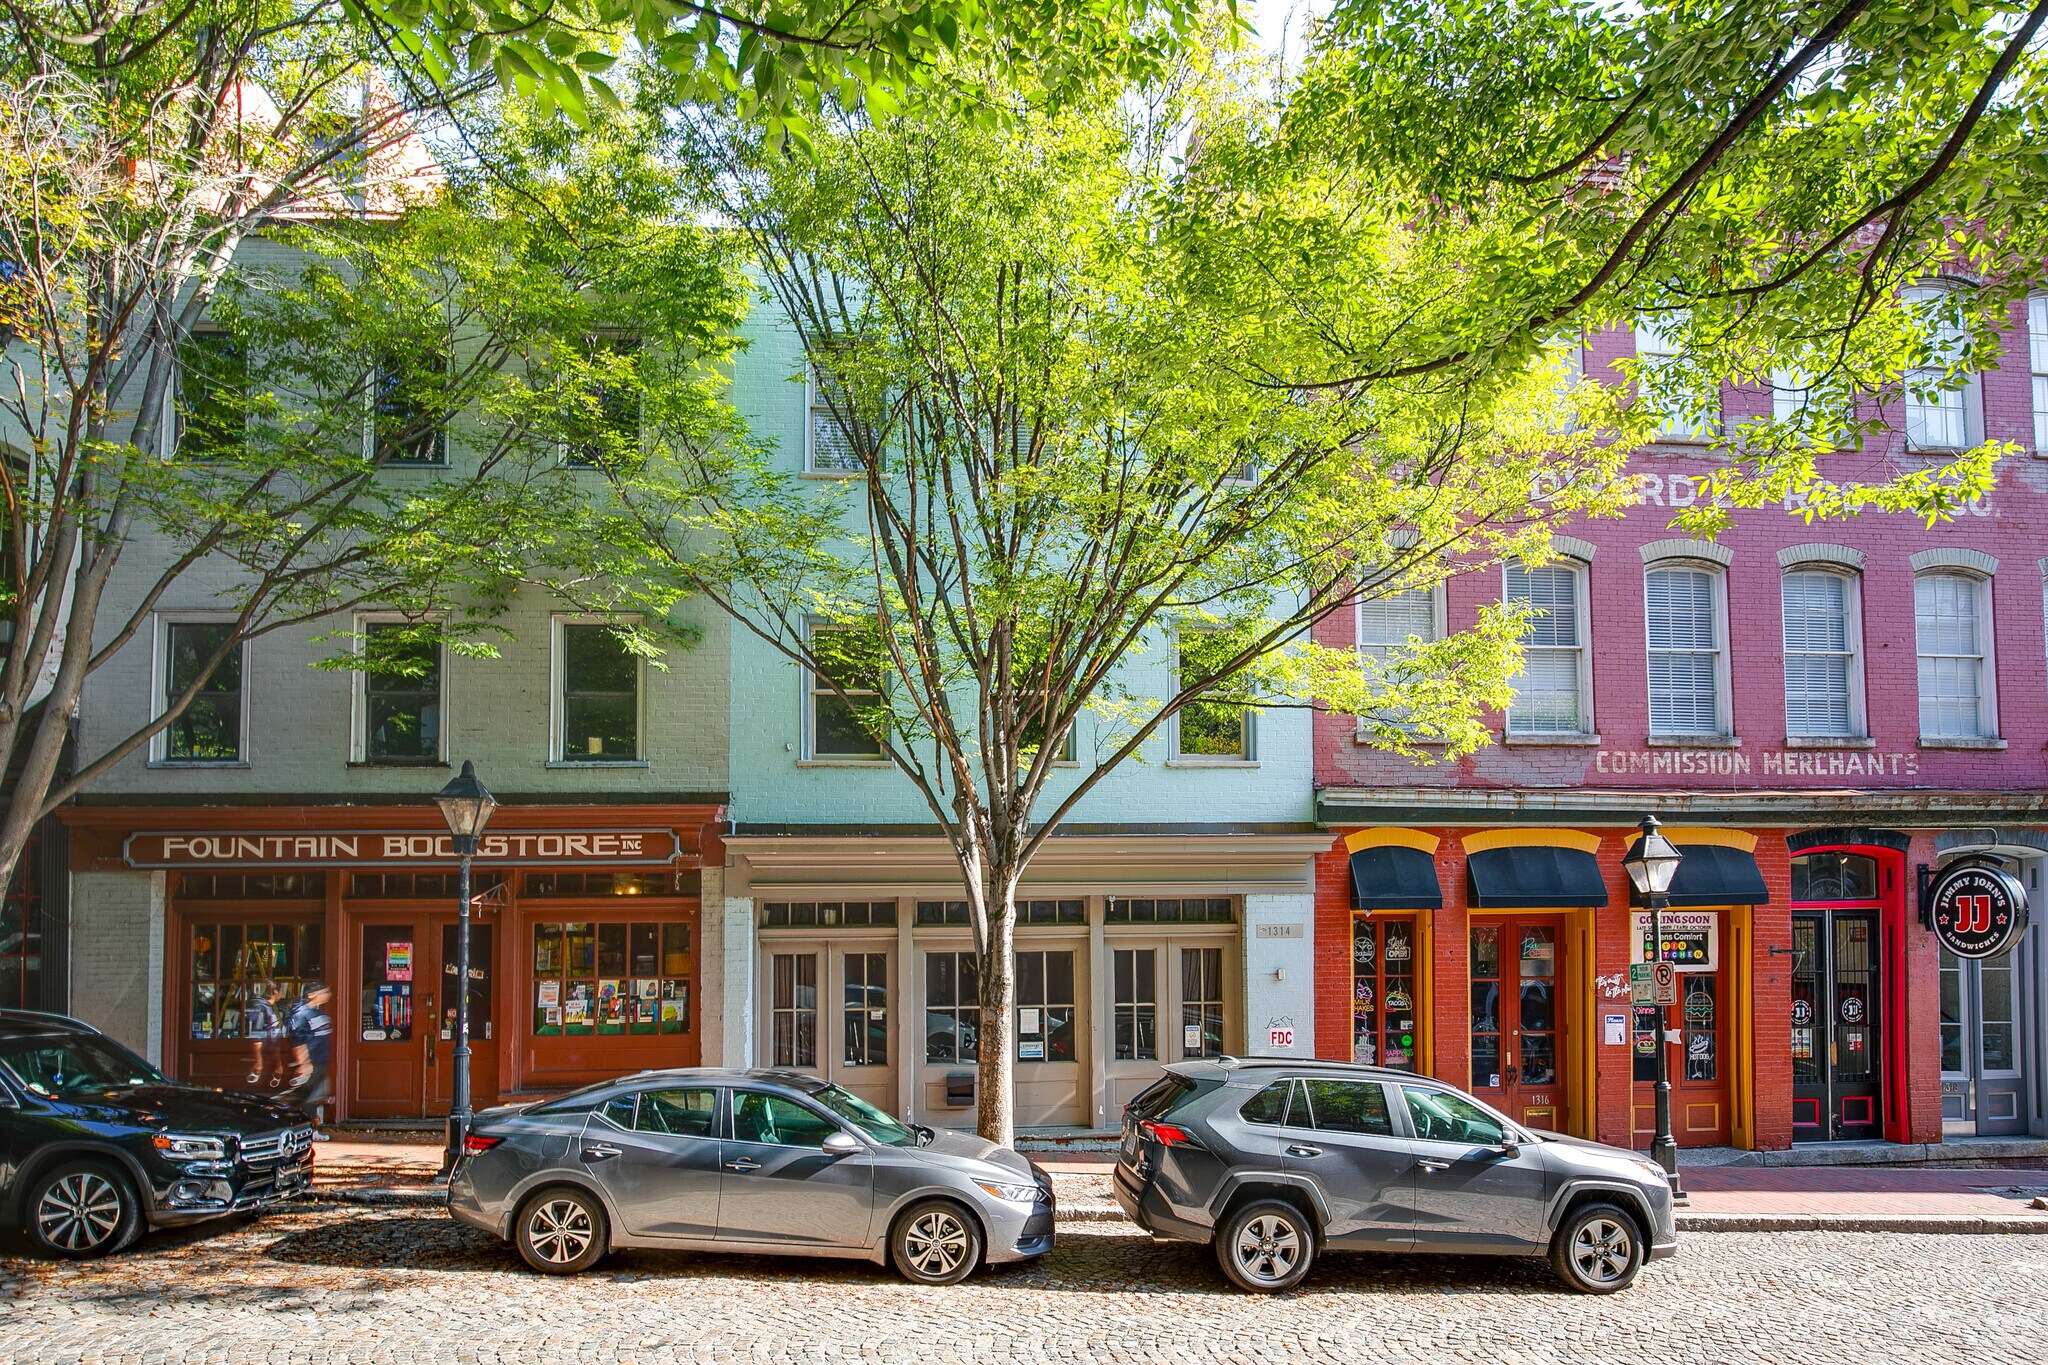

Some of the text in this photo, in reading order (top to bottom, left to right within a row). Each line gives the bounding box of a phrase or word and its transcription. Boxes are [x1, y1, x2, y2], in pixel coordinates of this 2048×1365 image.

[1596, 751, 1919, 775] COMMISSION MERCHANTS
[163, 834, 642, 858] FOUNTAIN BOOSTORE INC
[1940, 877, 2006, 908] JIMMY JOHN'S
[1639, 915, 1711, 925] COING SOON
[1954, 895, 1991, 933] JJ
[1268, 926, 1290, 937] 1314
[1673, 932, 1703, 941] Comfort
[1946, 931, 2000, 950] SANDWICHES
[1631, 968, 1637, 979] 2
[1354, 1004, 1374, 1012] HAKES
[1271, 1031, 1293, 1045] FDC
[1531, 1095, 1550, 1105] 1316
